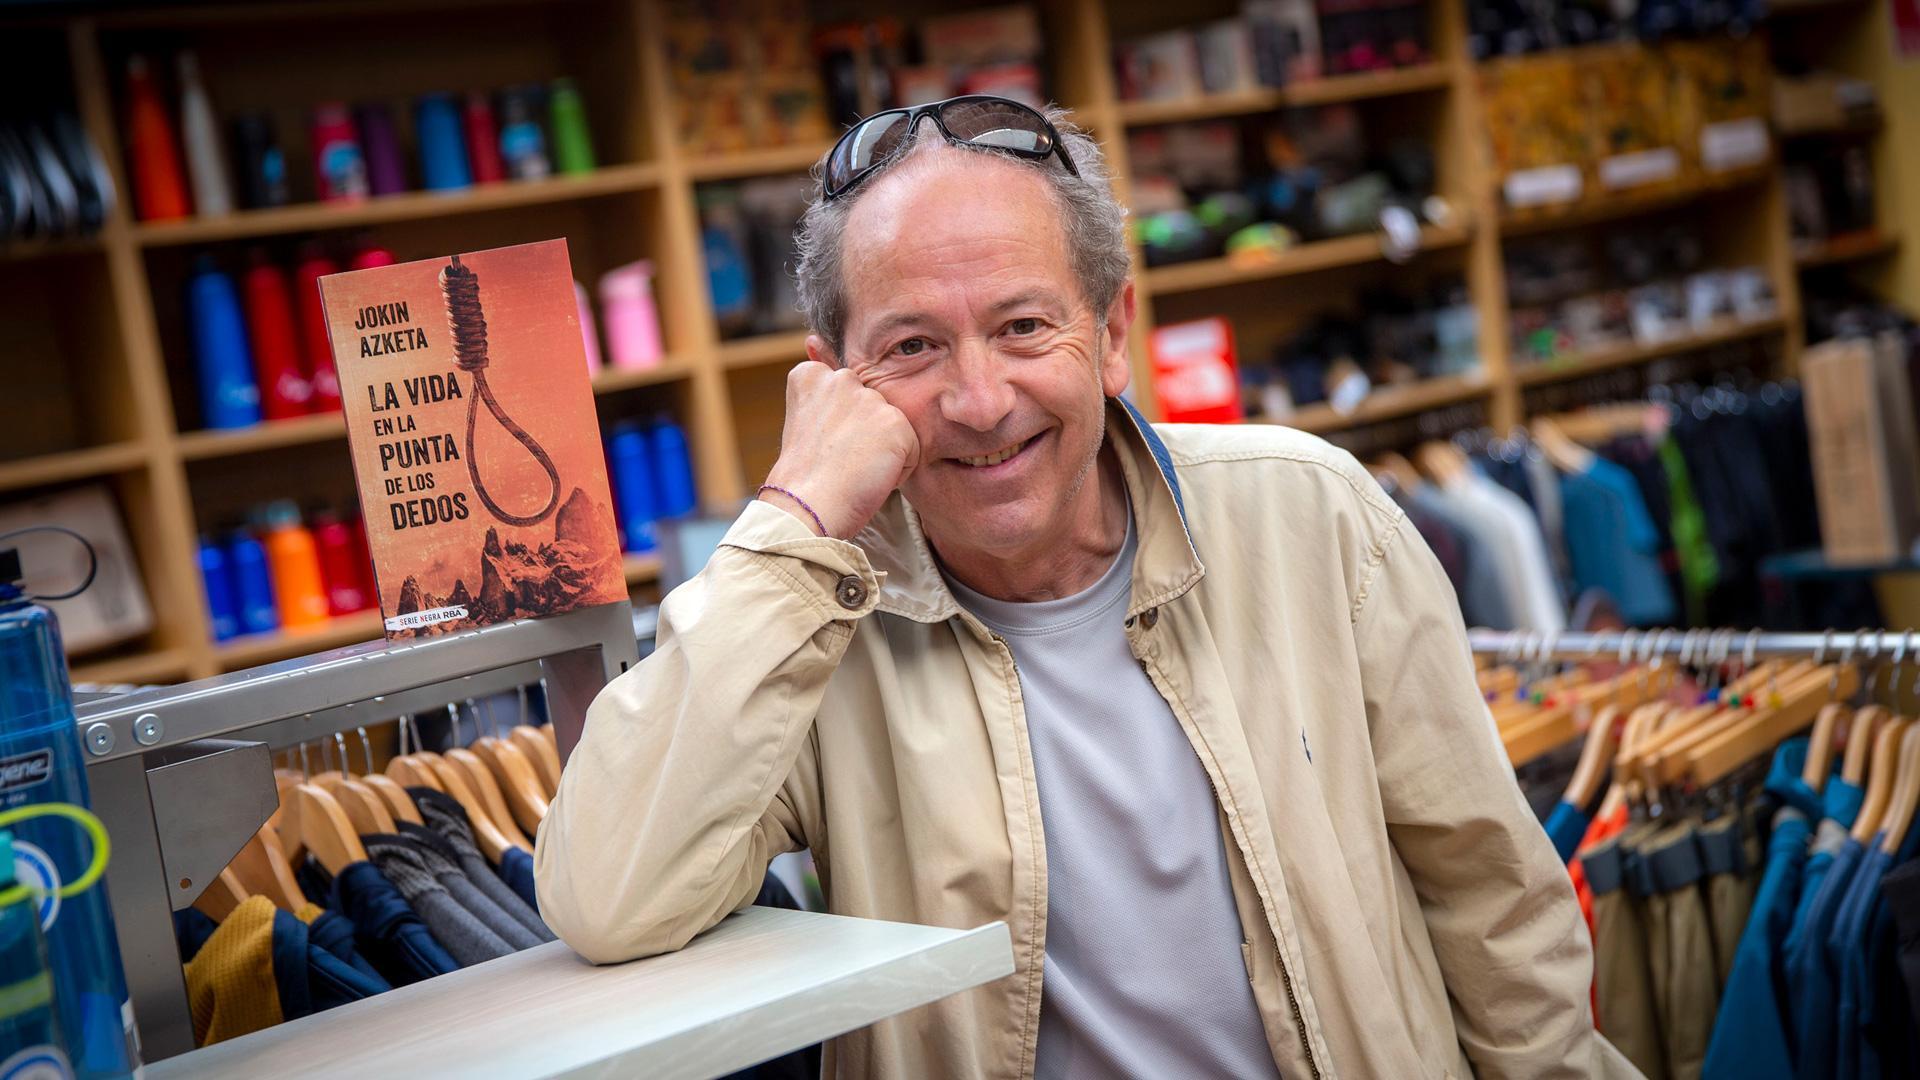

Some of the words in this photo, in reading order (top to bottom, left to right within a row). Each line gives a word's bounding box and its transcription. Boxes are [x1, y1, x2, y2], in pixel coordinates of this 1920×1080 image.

[355, 301, 410, 330] JOKIN
[361, 327, 428, 358] AZKETA
[368, 382, 400, 412] LA
[403, 372, 462, 406] VIDA
[374, 418, 394, 436] EN
[397, 415, 416, 433] LA
[379, 434, 460, 471] PUNTA
[385, 477, 404, 496] DE
[407, 472, 435, 492] LOS
[390, 492, 469, 530] DEDOS
[400, 616, 418, 626] SERIE
[420, 613, 442, 622] NEGRA
[443, 609, 462, 619] RBA
